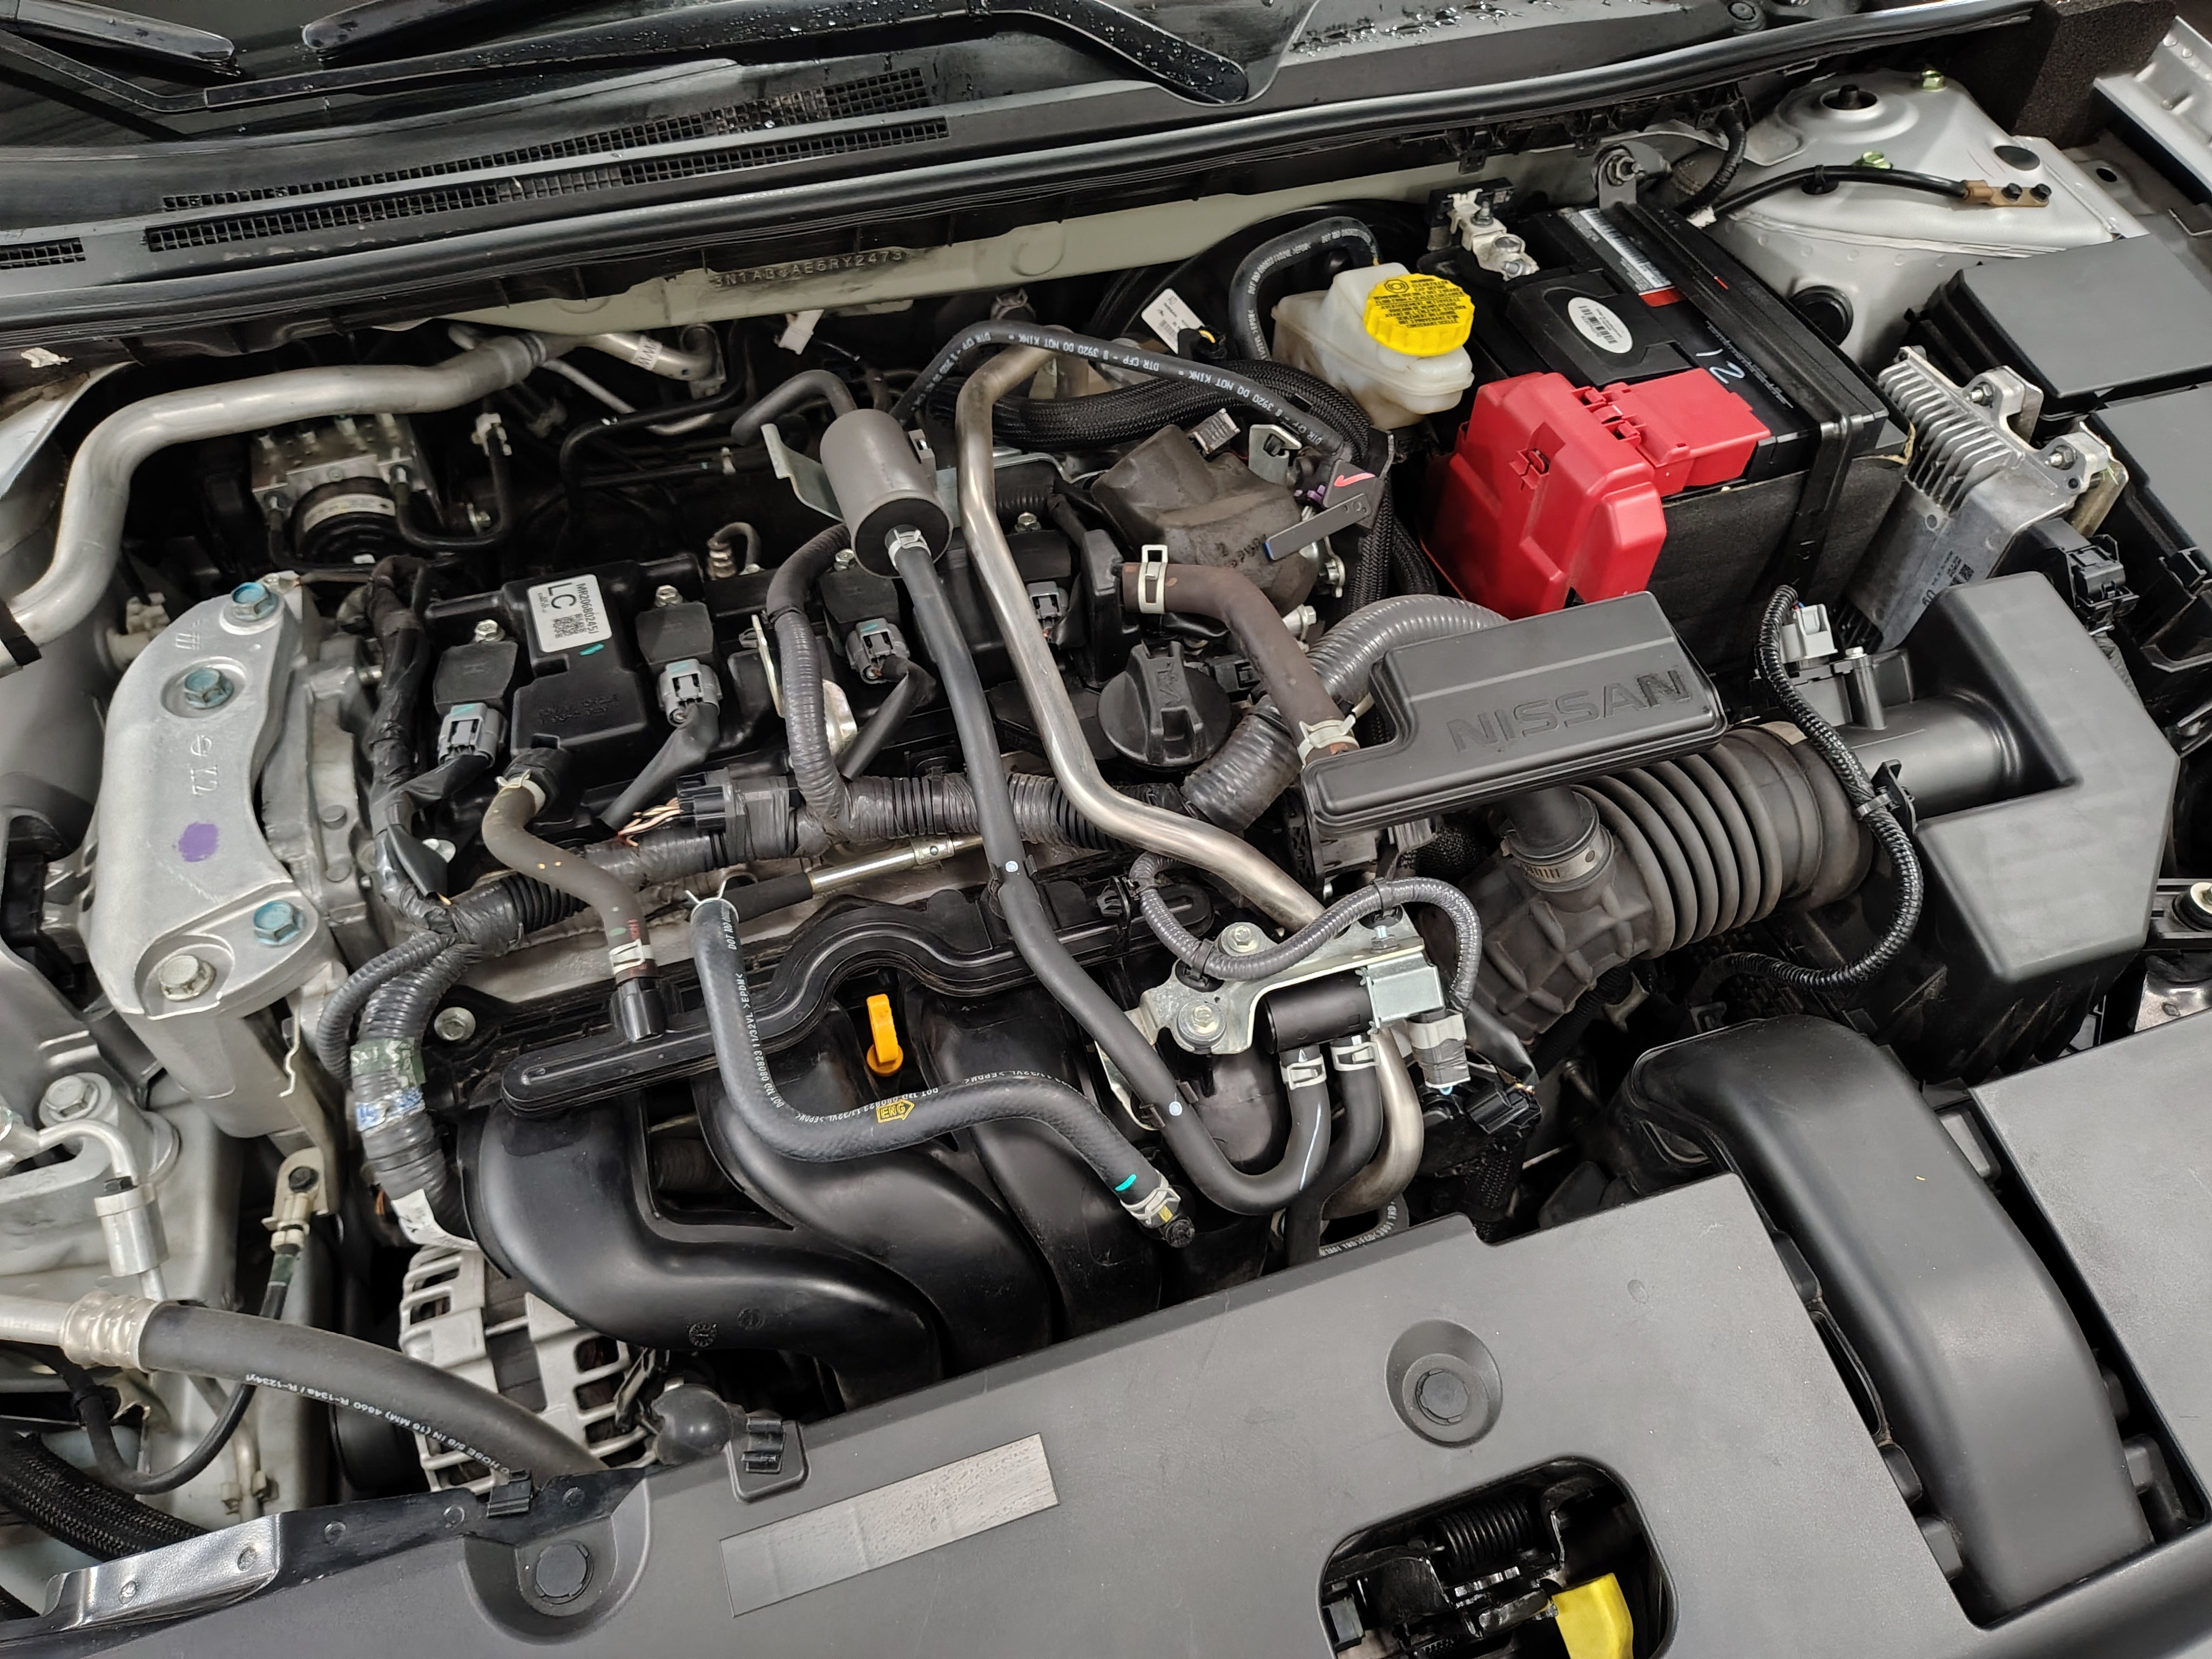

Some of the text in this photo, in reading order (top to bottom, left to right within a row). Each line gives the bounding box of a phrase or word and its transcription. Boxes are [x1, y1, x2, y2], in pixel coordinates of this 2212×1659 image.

[1044, 338, 1059, 350] NOT
[1078, 345, 1099, 357] 3920
[1123, 355, 1139, 366] CFP
[1143, 360, 1159, 371] DTR
[1189, 370, 1211, 383] KINK
[1215, 378, 1235, 390] NOT
[1237, 385, 1250, 397] DO
[1252, 394, 1274, 411] 3920
[548, 583, 576, 609] LC
[1447, 669, 1694, 753] NISSAN
[727, 934, 737, 949] DOT
[736, 973, 752, 1009] >EPDM<
[754, 1049, 771, 1083] 080823
[921, 1086, 939, 1096] DOT
[771, 1094, 785, 1108] DOT
[880, 1102, 906, 1120] ENG
[307, 1388, 349, 1405] R-134a
[386, 1411, 410, 1426] MM)
[433, 1432, 446, 1441] IN
[467, 1448, 500, 1469] HOSE
